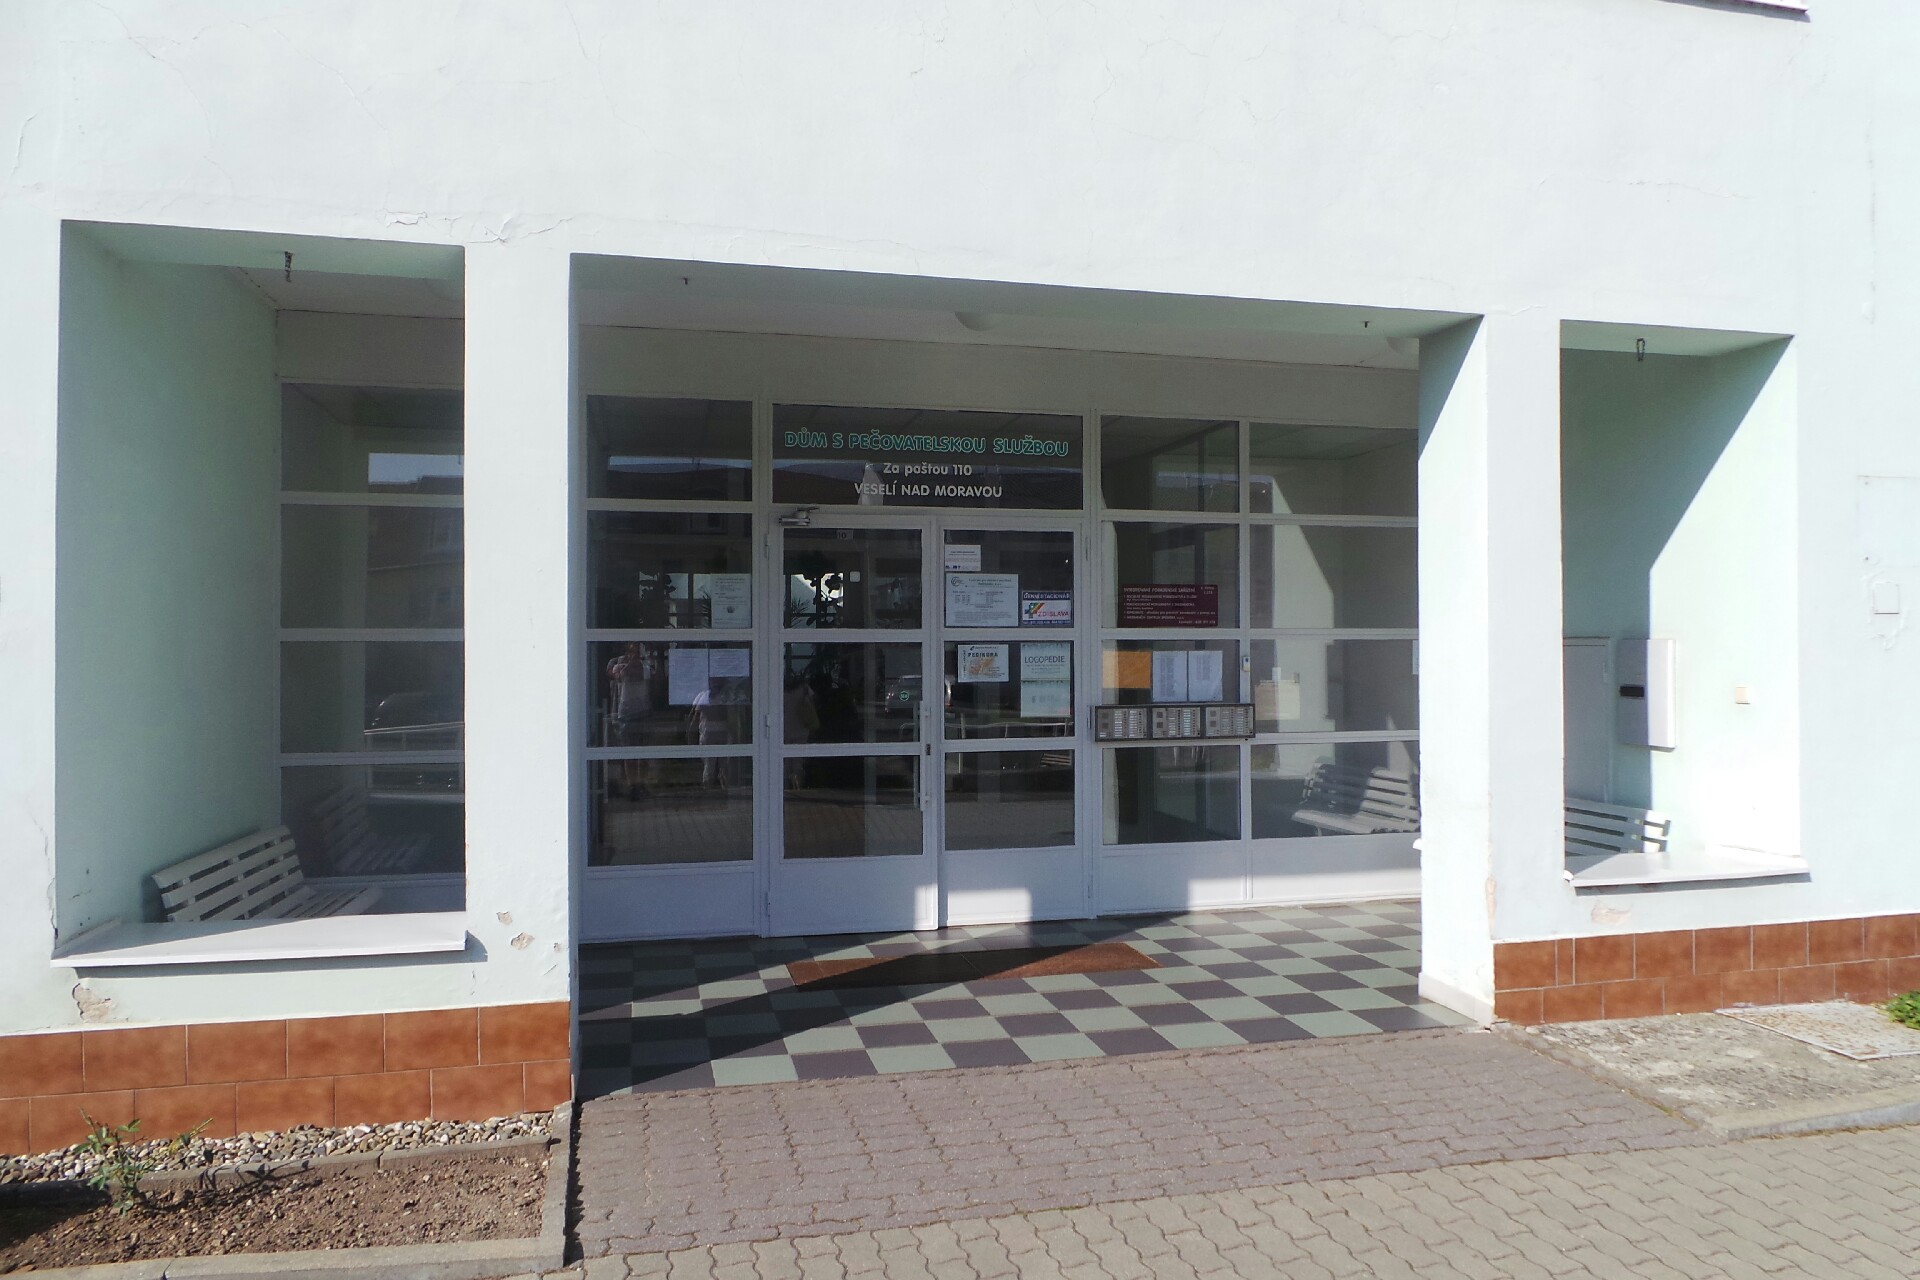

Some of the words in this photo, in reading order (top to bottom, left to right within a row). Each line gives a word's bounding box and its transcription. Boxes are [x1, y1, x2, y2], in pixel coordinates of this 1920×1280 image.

[784, 427, 828, 449] DŮM
[832, 432, 844, 449] S
[849, 429, 986, 454] PEČOVATELSKOU
[993, 435, 1069, 457] SLUŽBOU
[883, 461, 900, 474] Za
[952, 464, 973, 476] 110
[854, 480, 896, 496] VESELÍ
[901, 484, 930, 496] NAD
[934, 485, 1003, 498] MORAVOU
[1024, 655, 1065, 664] LOGOPEDIE
